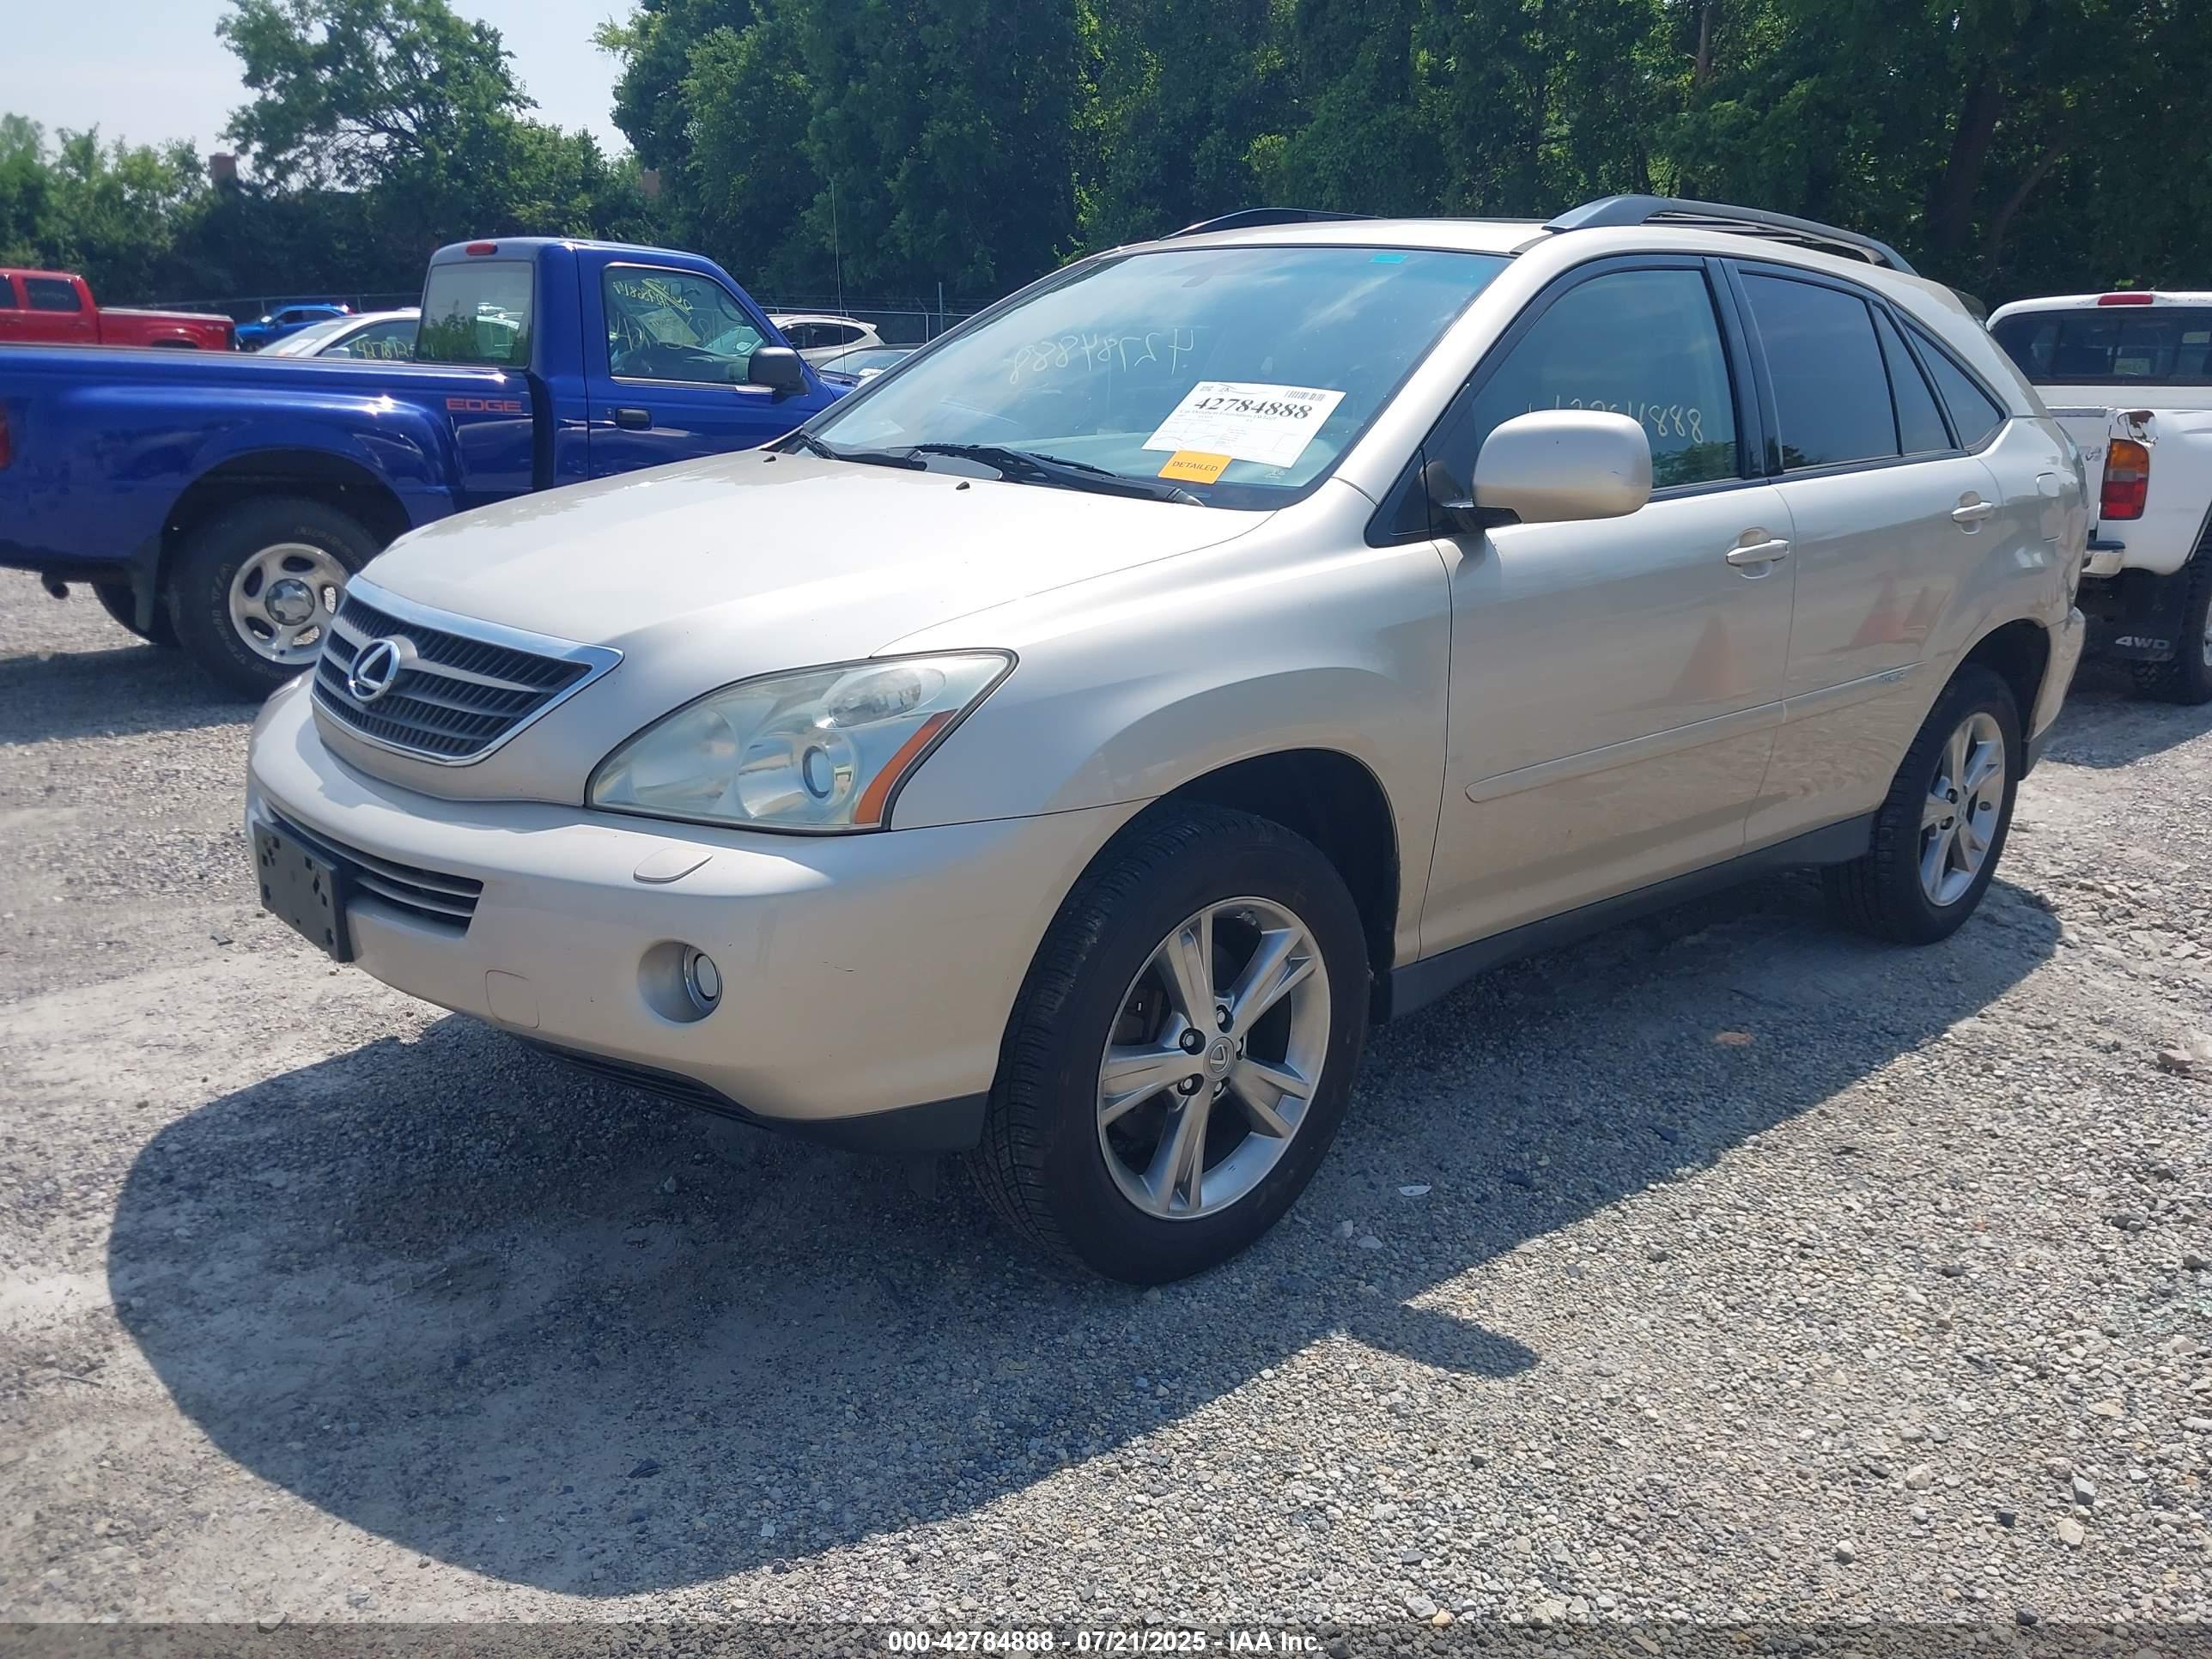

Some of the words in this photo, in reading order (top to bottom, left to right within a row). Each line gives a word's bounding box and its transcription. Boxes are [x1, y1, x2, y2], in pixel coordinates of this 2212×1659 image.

[446, 398, 523, 412] EDGE
[1194, 397, 1313, 420] 42784888
[1171, 460, 1218, 472] DETAILED
[2115, 635, 2171, 650] 4WD
